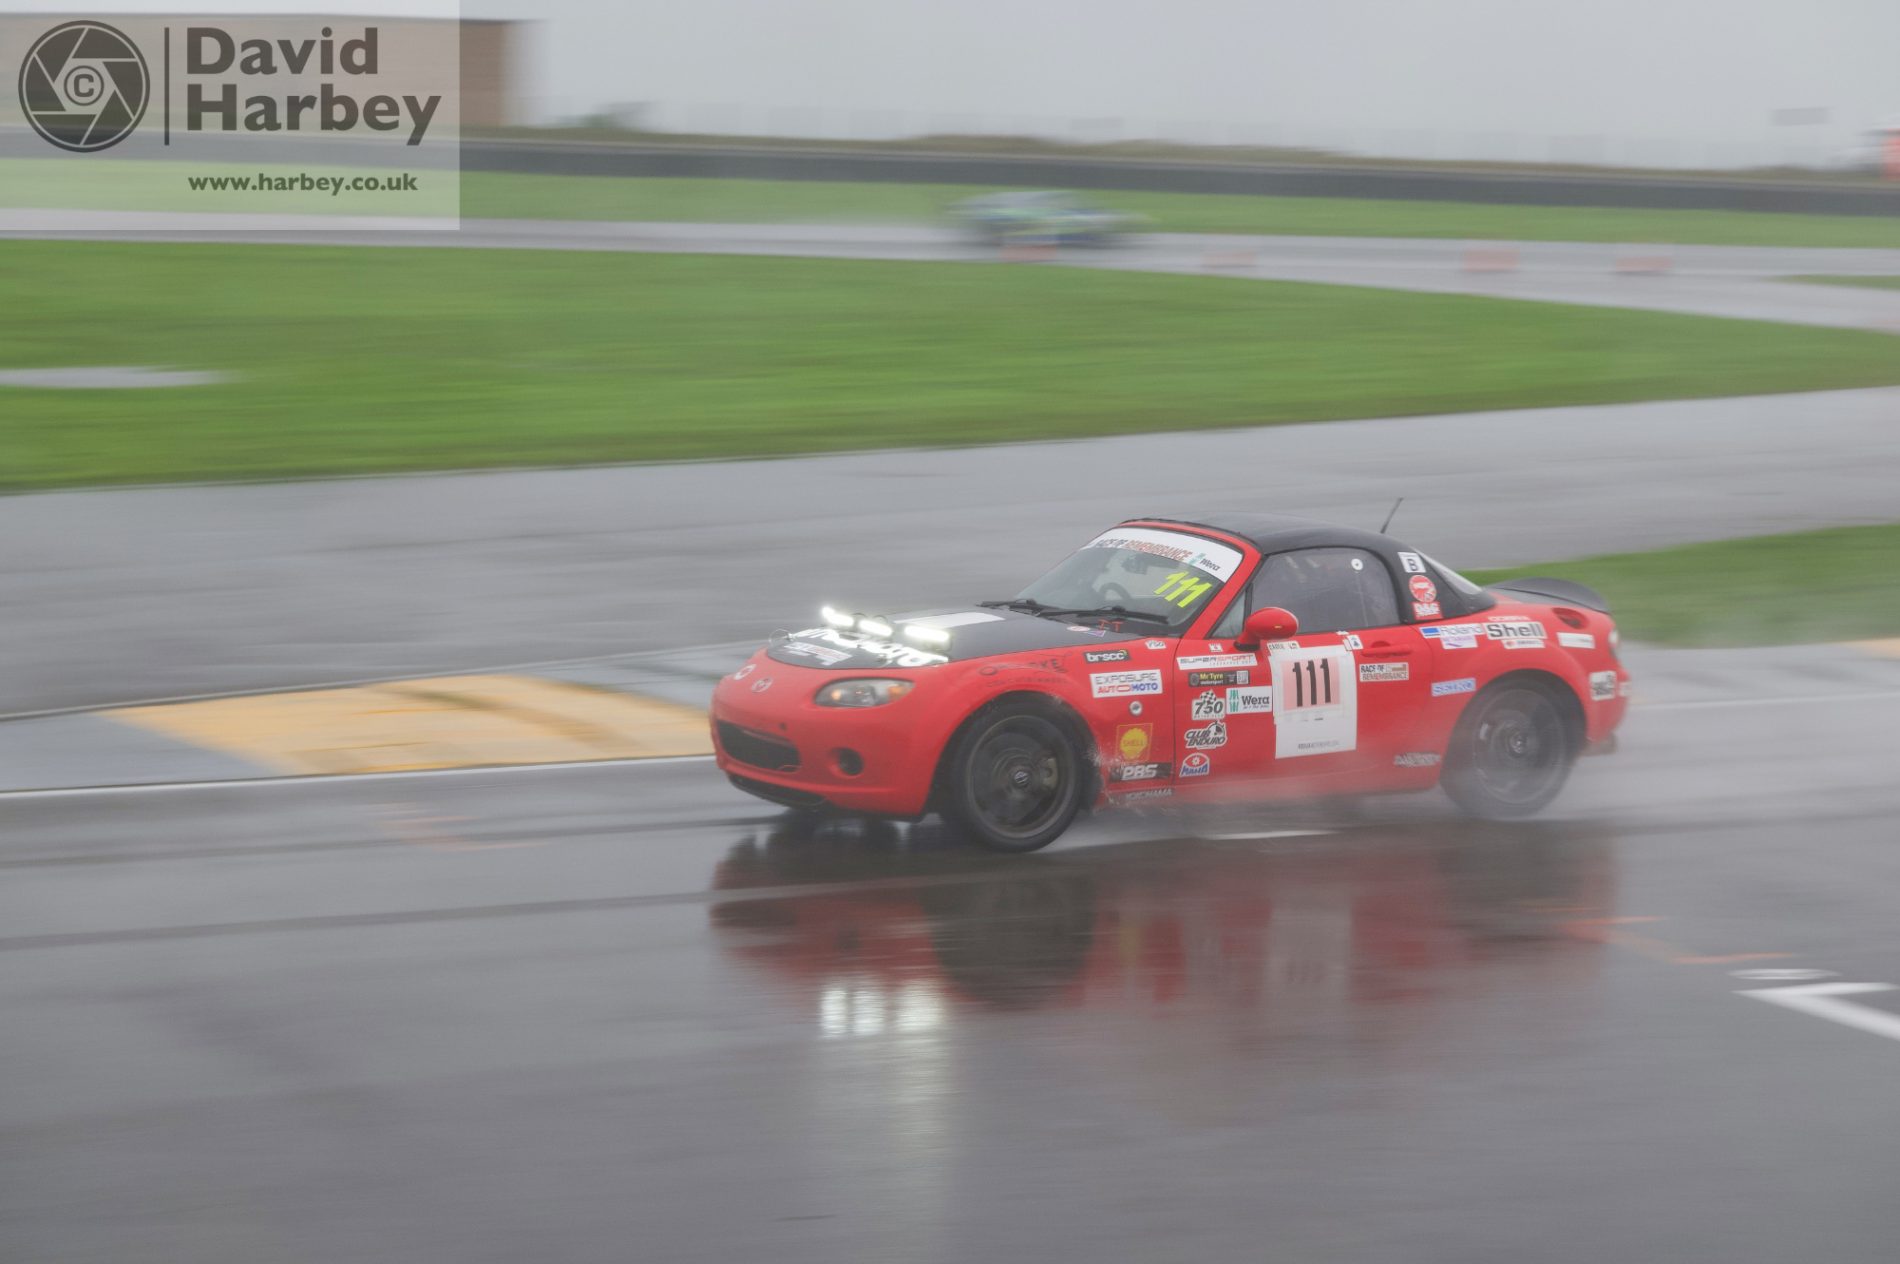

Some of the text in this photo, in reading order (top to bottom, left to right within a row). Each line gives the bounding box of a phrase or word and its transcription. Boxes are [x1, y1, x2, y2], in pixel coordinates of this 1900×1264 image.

[1199, 558, 1221, 572] Wera
[1407, 558, 1418, 572] B
[1153, 570, 1213, 609] 111
[1487, 623, 1545, 637] Shell
[1086, 652, 1124, 663] brscc
[1095, 672, 1158, 684] EXPOSURE
[1362, 671, 1408, 681] REMEMBRANCE
[1292, 658, 1332, 708] 111
[1241, 695, 1270, 706] Wera
[1194, 700, 1224, 715] 750
[1186, 730, 1211, 740] CLUB
[1188, 736, 1226, 747] ENDURO
